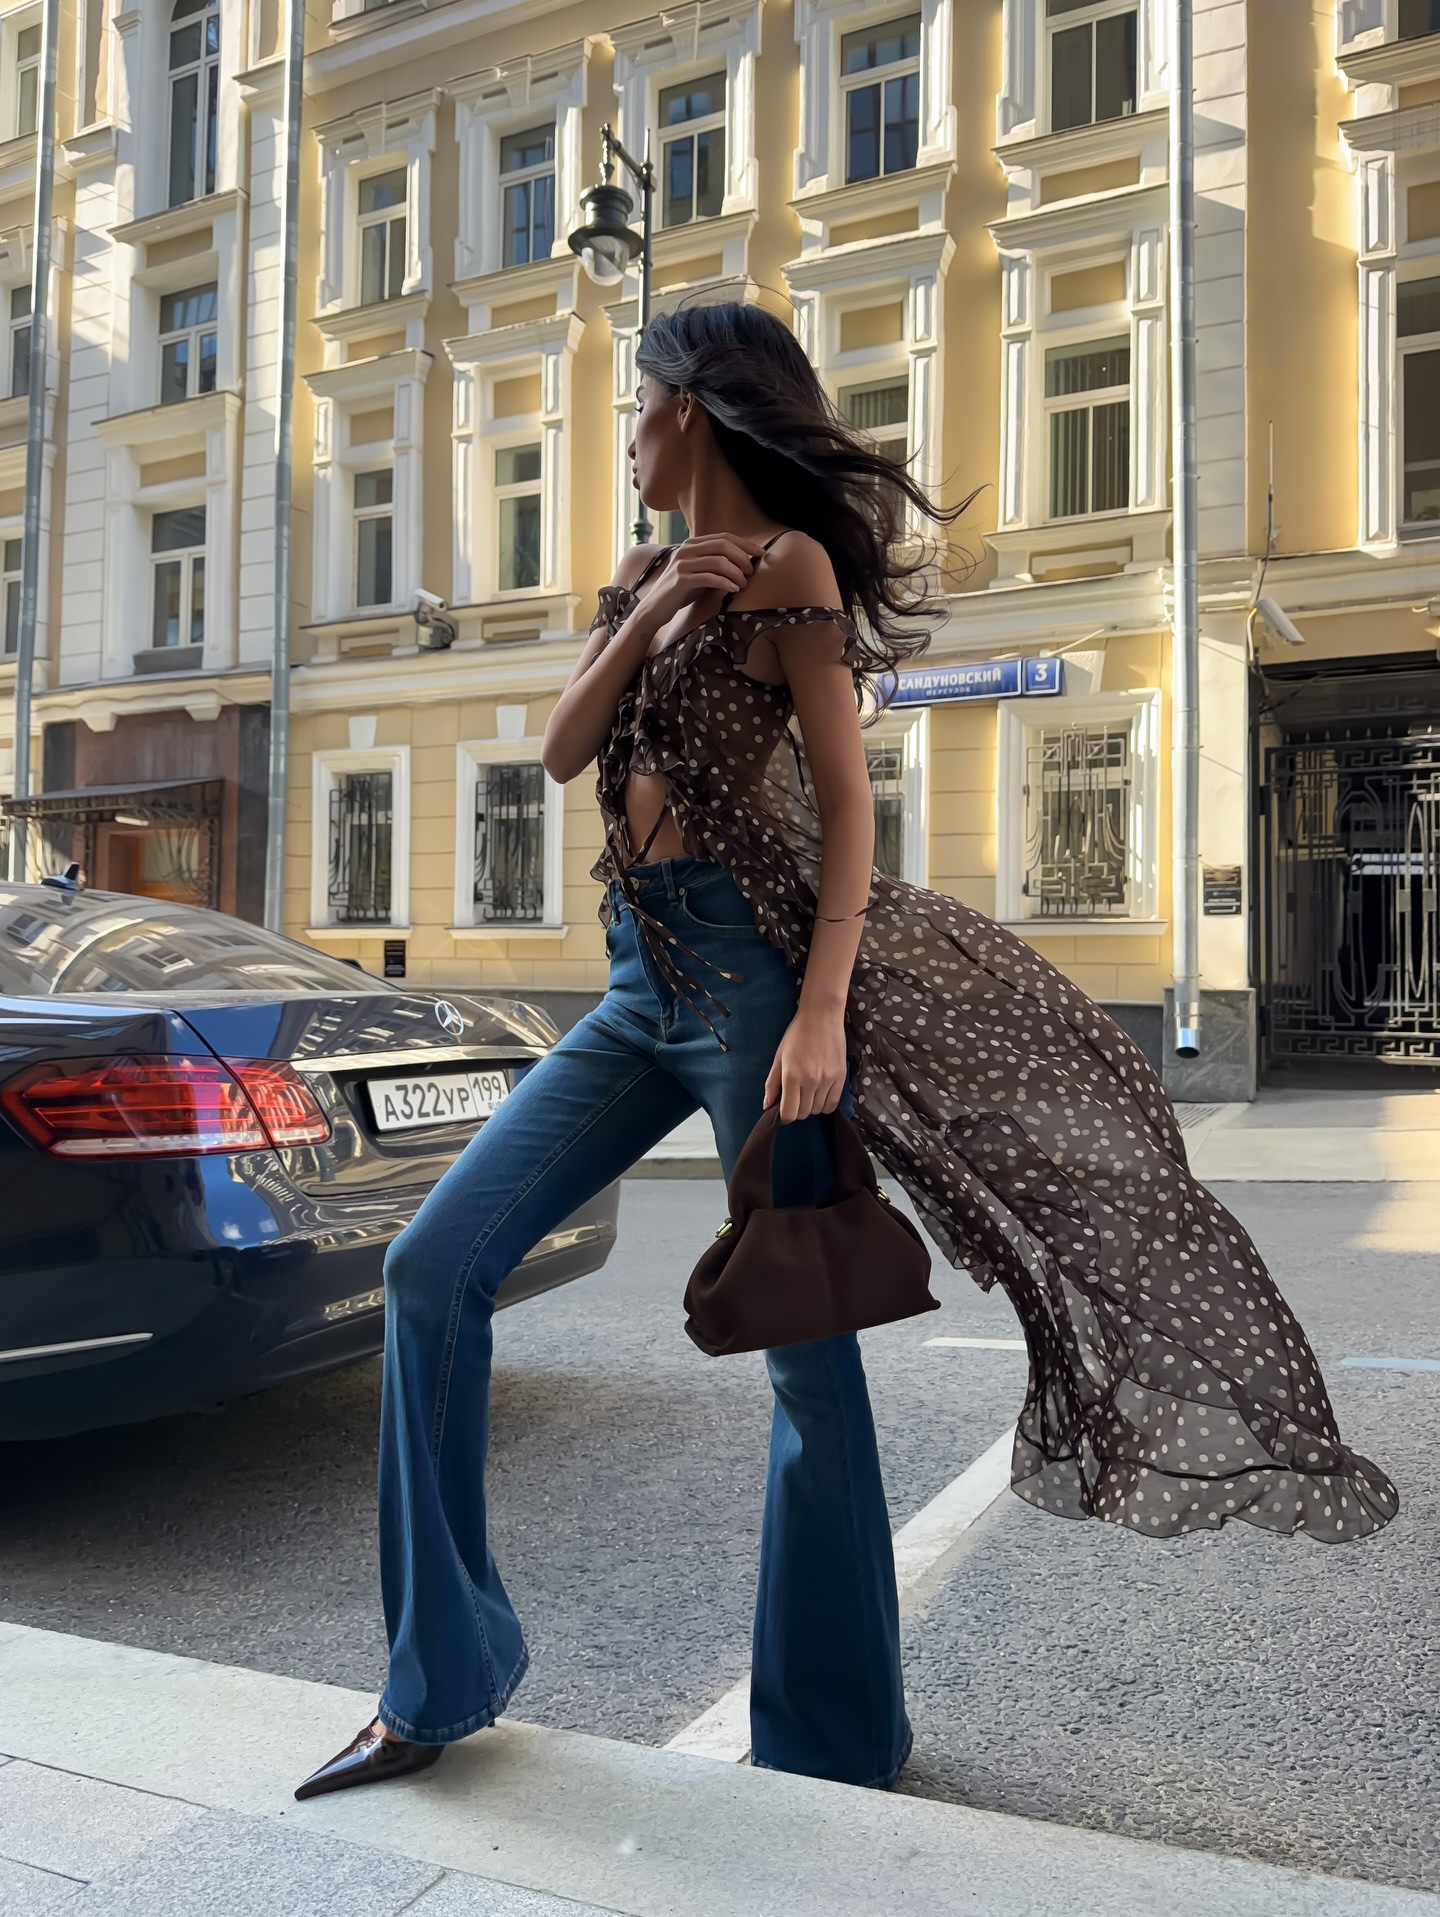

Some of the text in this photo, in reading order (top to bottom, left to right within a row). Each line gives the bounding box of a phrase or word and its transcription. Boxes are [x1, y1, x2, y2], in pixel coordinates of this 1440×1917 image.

[899, 667, 1002, 690] САНДУНОВСКИЙ
[1034, 663, 1048, 682] 3
[926, 686, 971, 697] ПЕРЕУЛОК
[472, 1075, 502, 1102] 199
